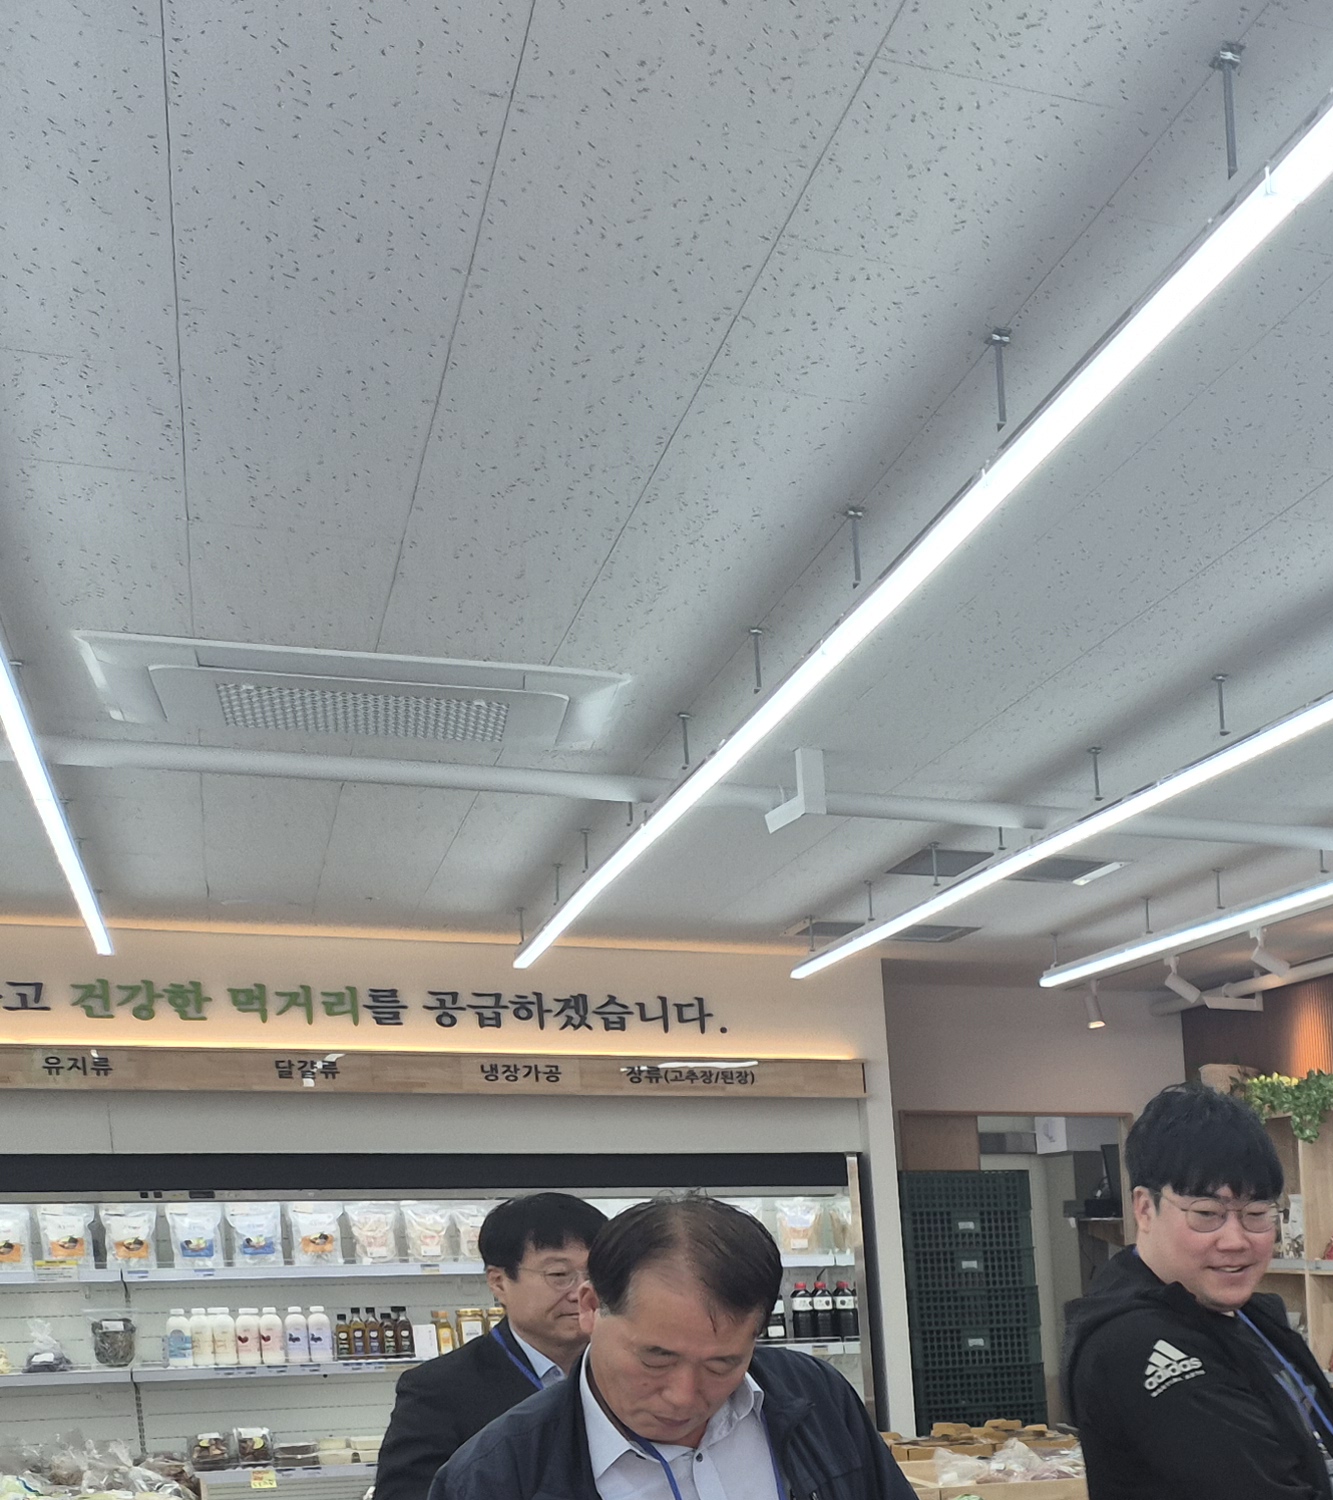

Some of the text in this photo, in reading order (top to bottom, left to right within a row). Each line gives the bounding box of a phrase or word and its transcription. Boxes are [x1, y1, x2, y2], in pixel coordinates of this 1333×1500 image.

[69, 978, 213, 1021] 건강한
[226, 982, 408, 1027] 먹거리를
[421, 990, 729, 1035] 공급하겠습니다.
[42, 1055, 113, 1077] 유지류
[480, 1063, 562, 1084] 냉장가공
[626, 1065, 755, 1085] 장류(고추장/된장)
[1144, 1357, 1203, 1391] adidas
